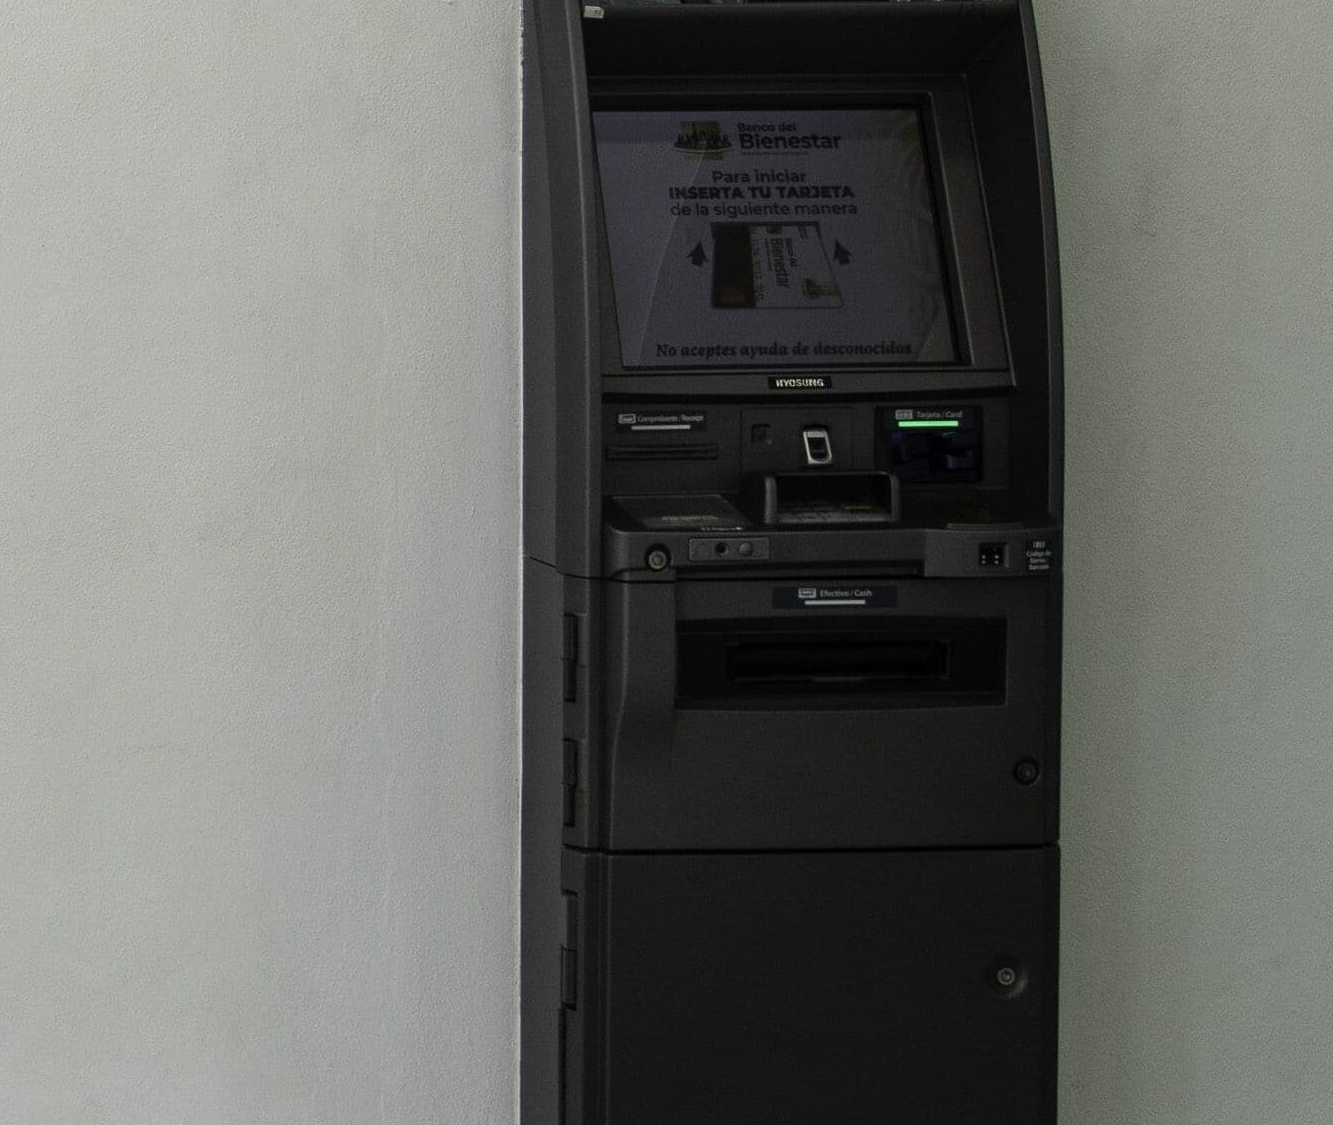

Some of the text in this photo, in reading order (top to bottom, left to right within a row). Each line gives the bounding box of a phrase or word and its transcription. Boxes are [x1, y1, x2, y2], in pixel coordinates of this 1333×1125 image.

[737, 123, 796, 132] Banco del
[739, 133, 841, 150] Bienestar
[712, 169, 807, 184] Para iniciar
[669, 186, 855, 200] INSERTA TU TARJETA
[670, 202, 858, 218] de la siguiente manera
[656, 340, 912, 359] No aceptes ayuda de desconocidos
[776, 378, 824, 387] HYOSUNG
